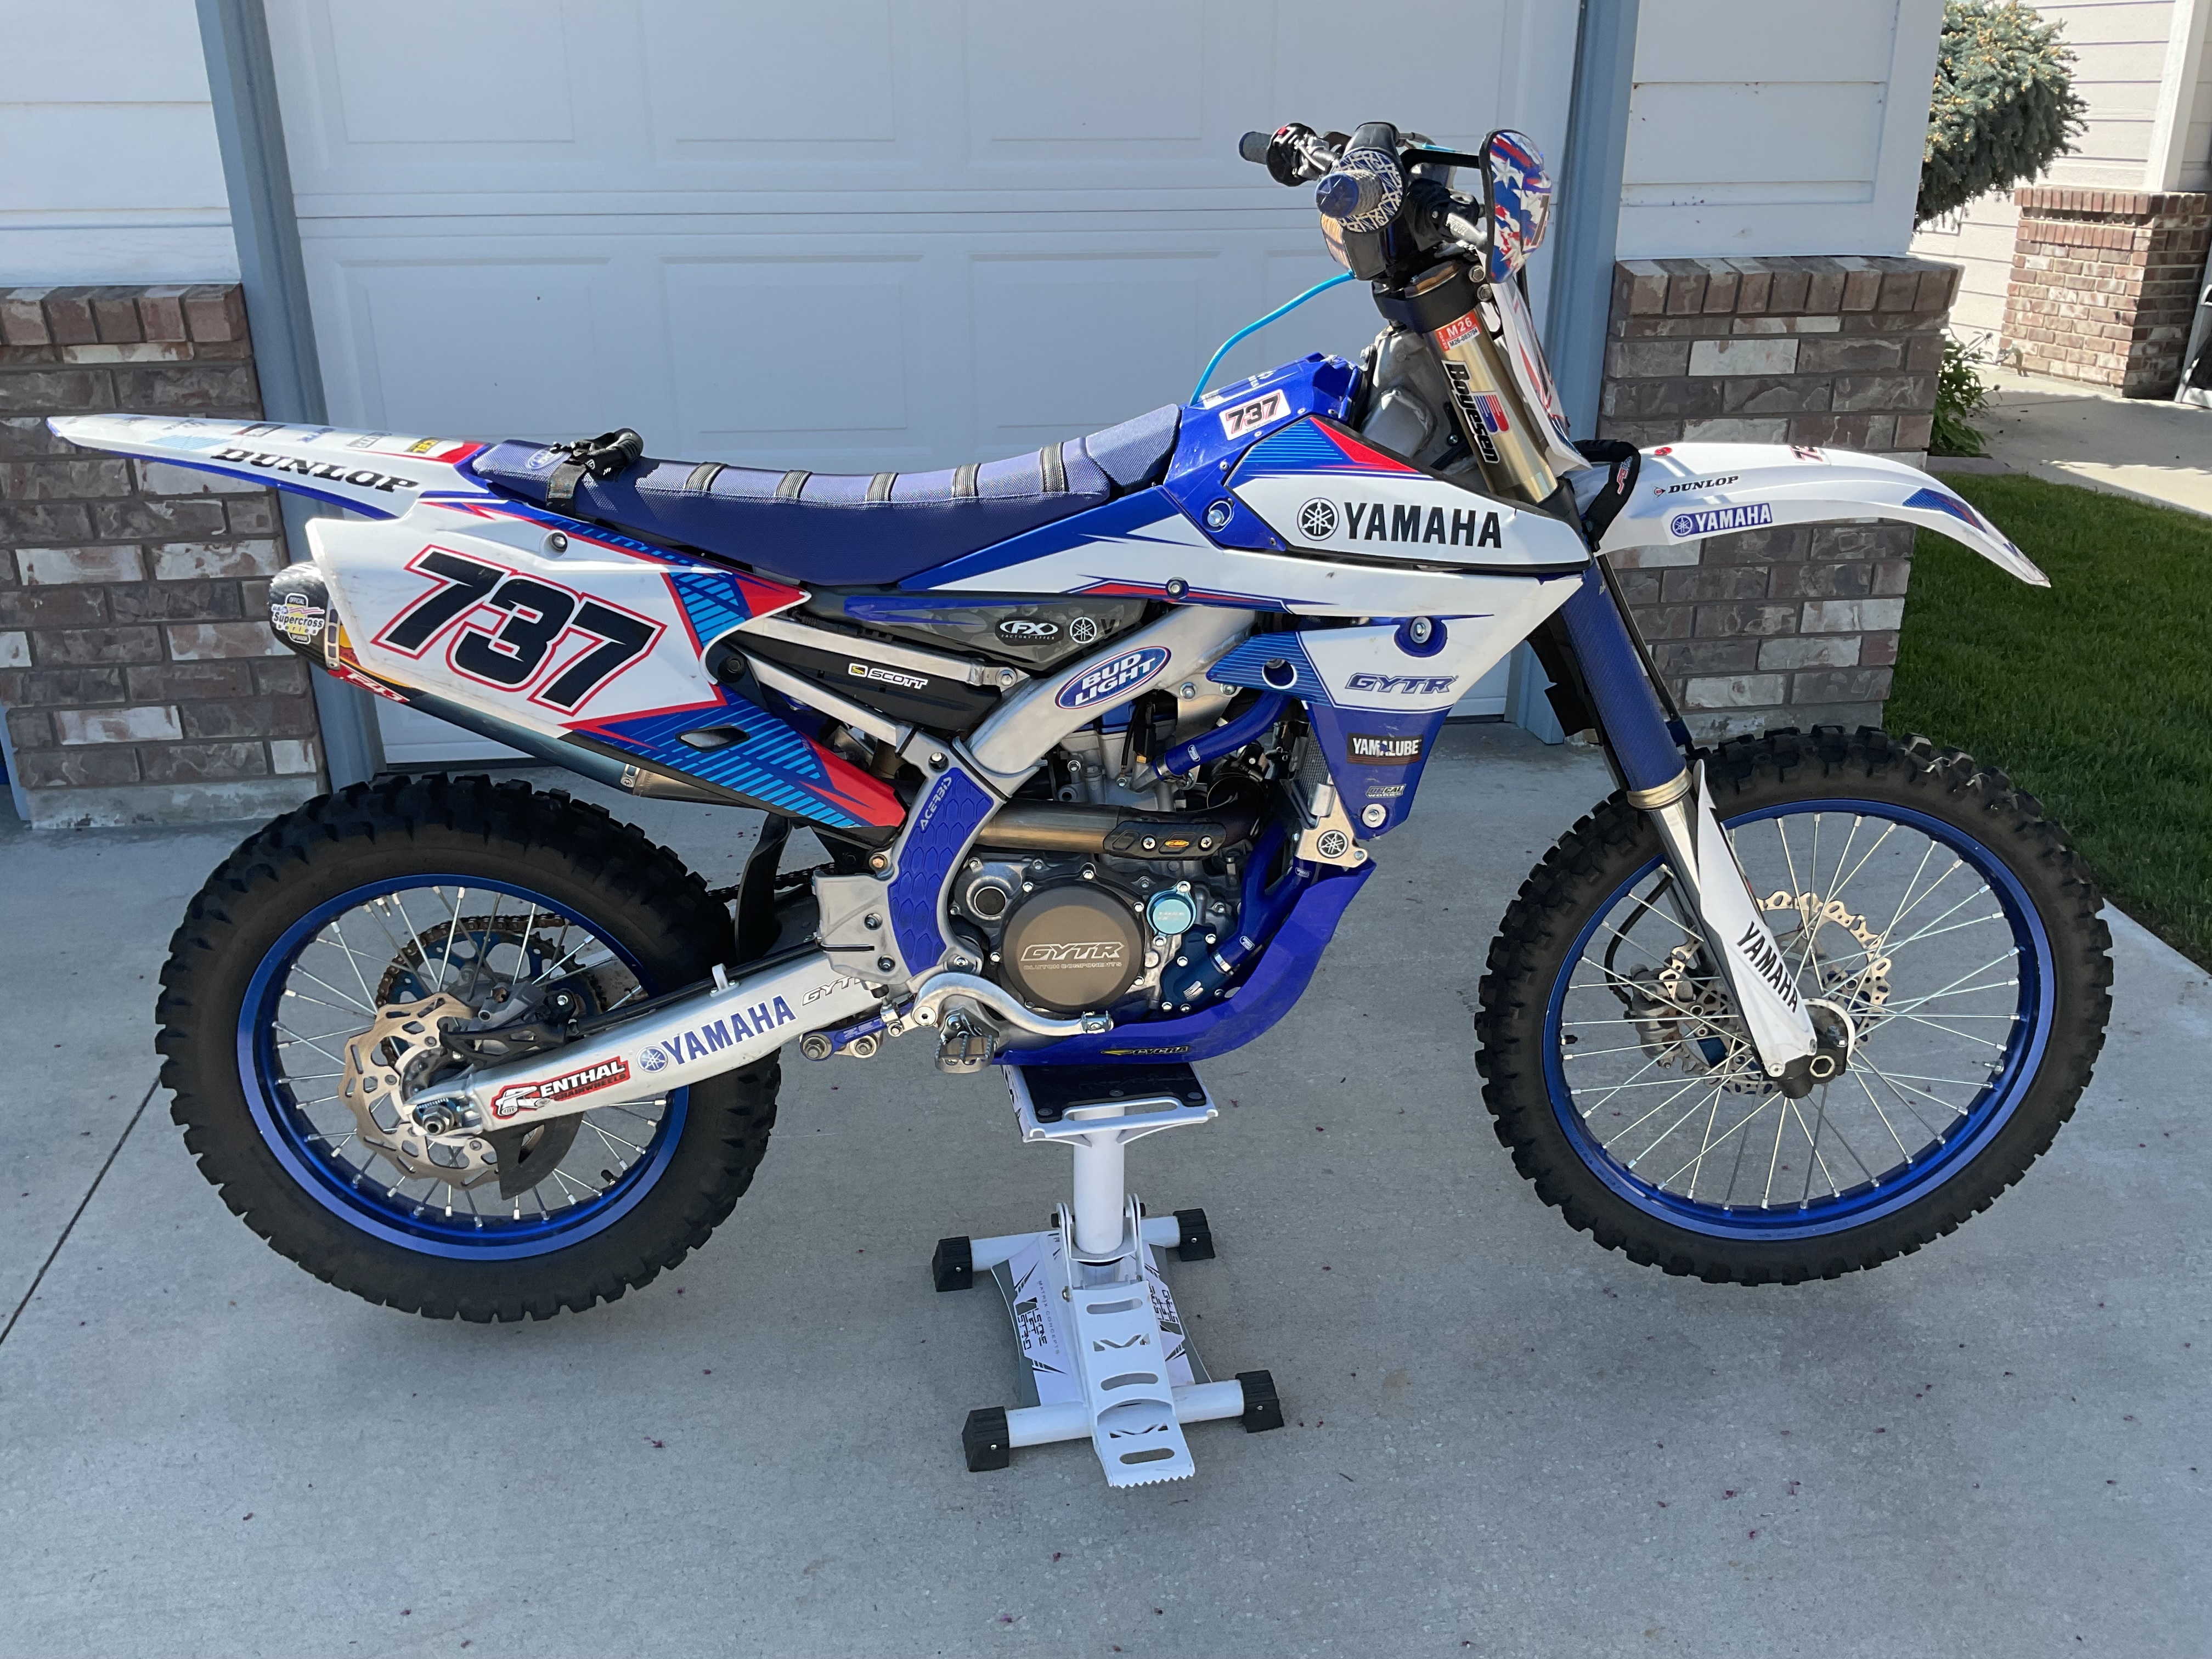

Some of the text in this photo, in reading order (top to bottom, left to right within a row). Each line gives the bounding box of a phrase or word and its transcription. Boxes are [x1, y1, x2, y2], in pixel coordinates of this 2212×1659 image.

[1447, 317, 1472, 337] M26
[1226, 392, 1280, 435] 737
[1443, 362, 1500, 462] Boyesen
[210, 448, 420, 493] DUNLOP
[1668, 476, 1739, 494] DUNLOP
[1344, 502, 1502, 548] YAMAHA
[1695, 504, 1771, 532] YAMAHA
[274, 612, 324, 628] Supercross
[370, 544, 667, 716] 737
[870, 669, 927, 689] SCOTT
[1075, 657, 1156, 706] LIGHT
[1081, 653, 1142, 690] BUD
[1345, 673, 1457, 693] GYTR
[1020, 941, 1125, 961] GYTR
[1060, 961, 1122, 969] COMPONENTS
[1737, 921, 1797, 1013] YAMAHA
[661, 995, 797, 1065] YAMAHA
[495, 1061, 625, 1116] RENTHAL
[1037, 1280, 1060, 1355] MATRIX CONCEPTS
